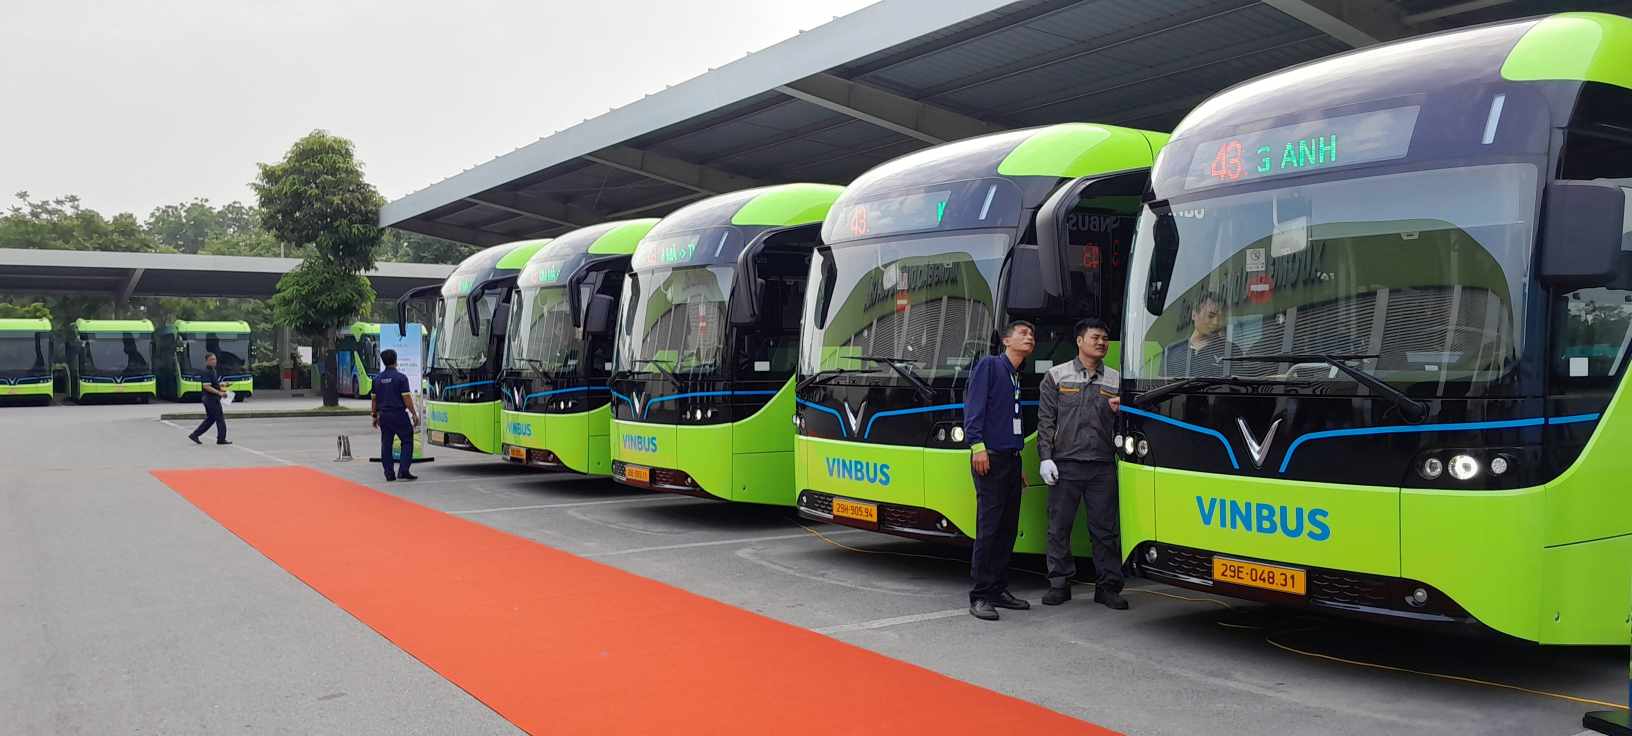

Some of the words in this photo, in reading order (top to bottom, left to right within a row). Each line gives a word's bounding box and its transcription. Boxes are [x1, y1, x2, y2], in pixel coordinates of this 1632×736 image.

[1281, 134, 1337, 169] ANH
[622, 433, 658, 453] VINBUS
[825, 456, 891, 487] VINBUS
[1195, 494, 1332, 542] VINBUS
[1219, 562, 1297, 589] 29E-048.31
